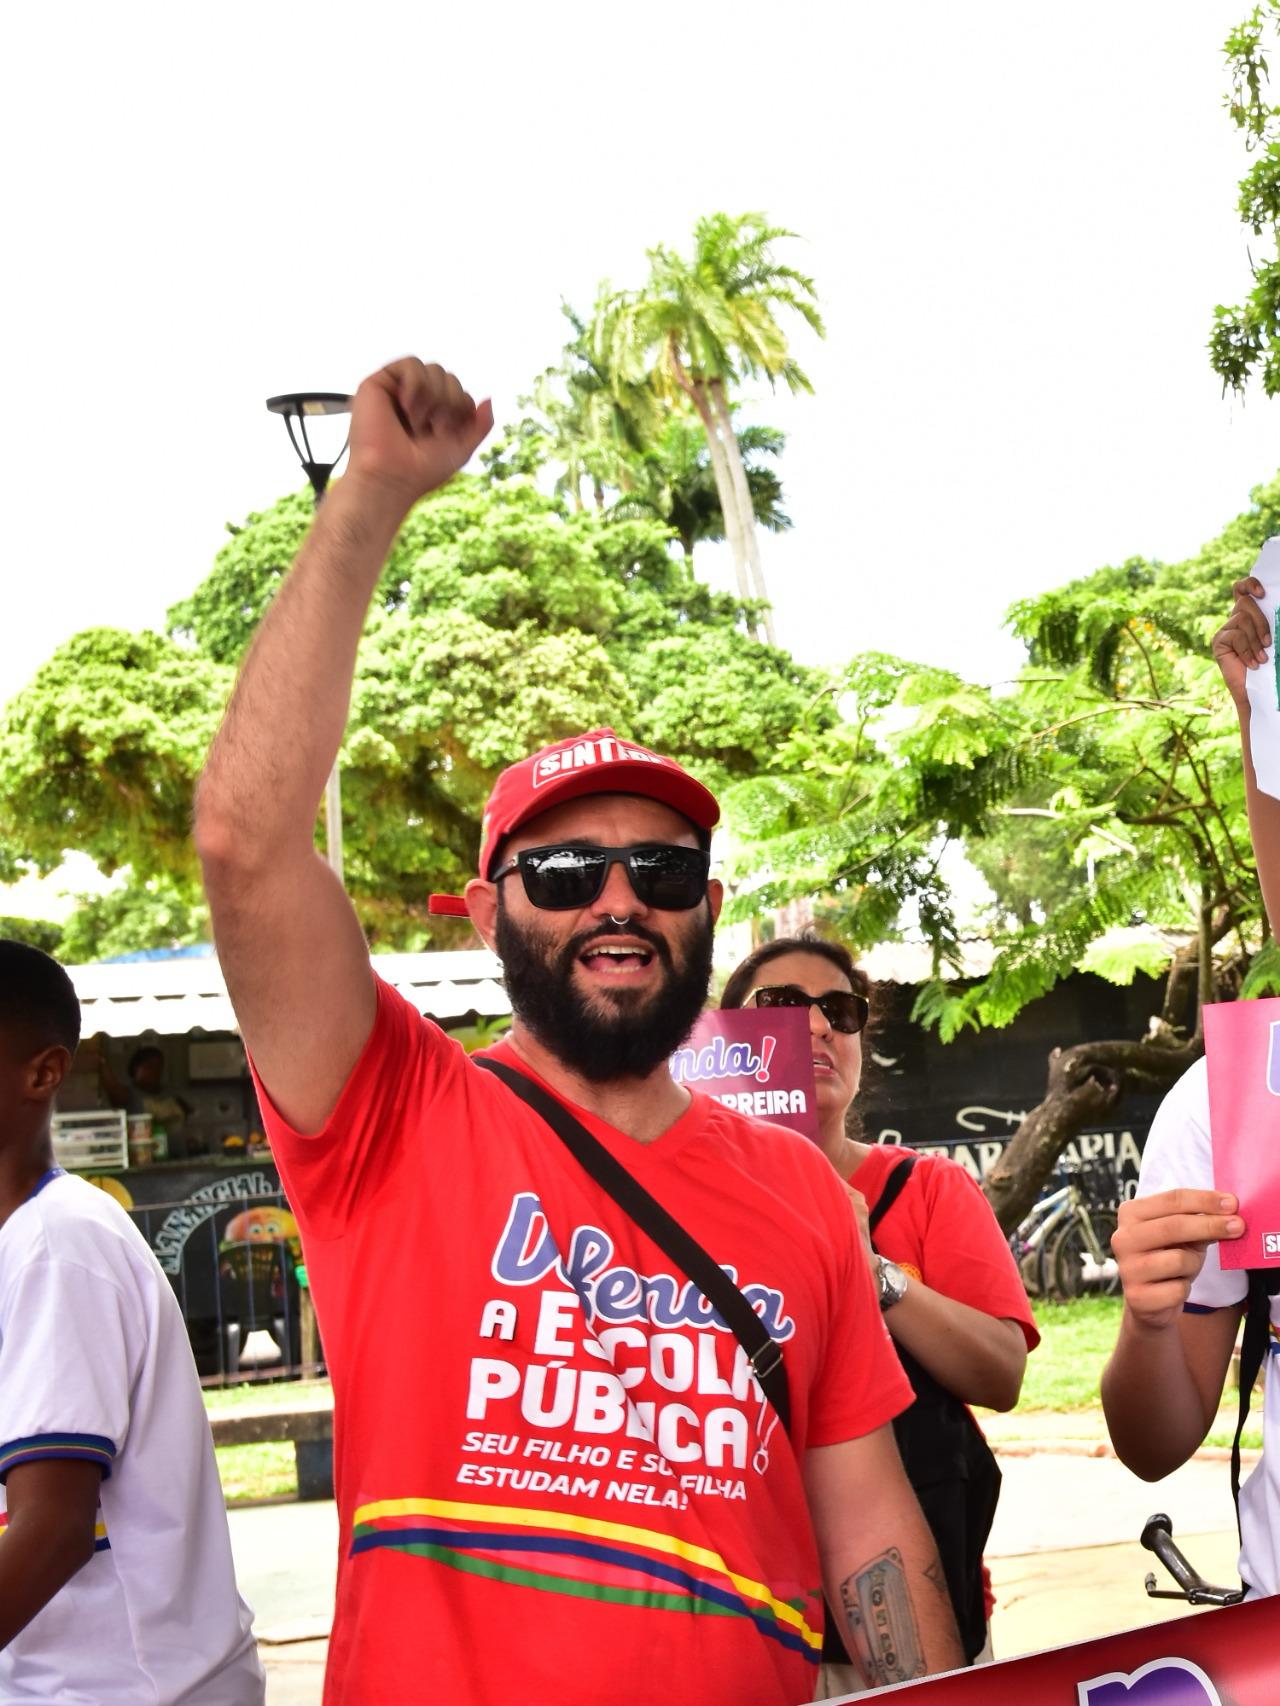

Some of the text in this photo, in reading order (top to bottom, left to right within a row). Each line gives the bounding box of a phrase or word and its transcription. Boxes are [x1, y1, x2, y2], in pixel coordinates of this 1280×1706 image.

[539, 737, 664, 777] SINT
[668, 1036, 776, 1083] nda!
[711, 1089, 807, 1116] RREIRA
[491, 1192, 796, 1343] Dfena
[479, 1290, 768, 1403] A ECOLA
[461, 1431, 520, 1456] SEU
[523, 1438, 612, 1467] FILHO
[616, 1449, 638, 1471] E
[640, 1453, 679, 1479] SU
[456, 1463, 689, 1511] ESTUDAM NELA!
